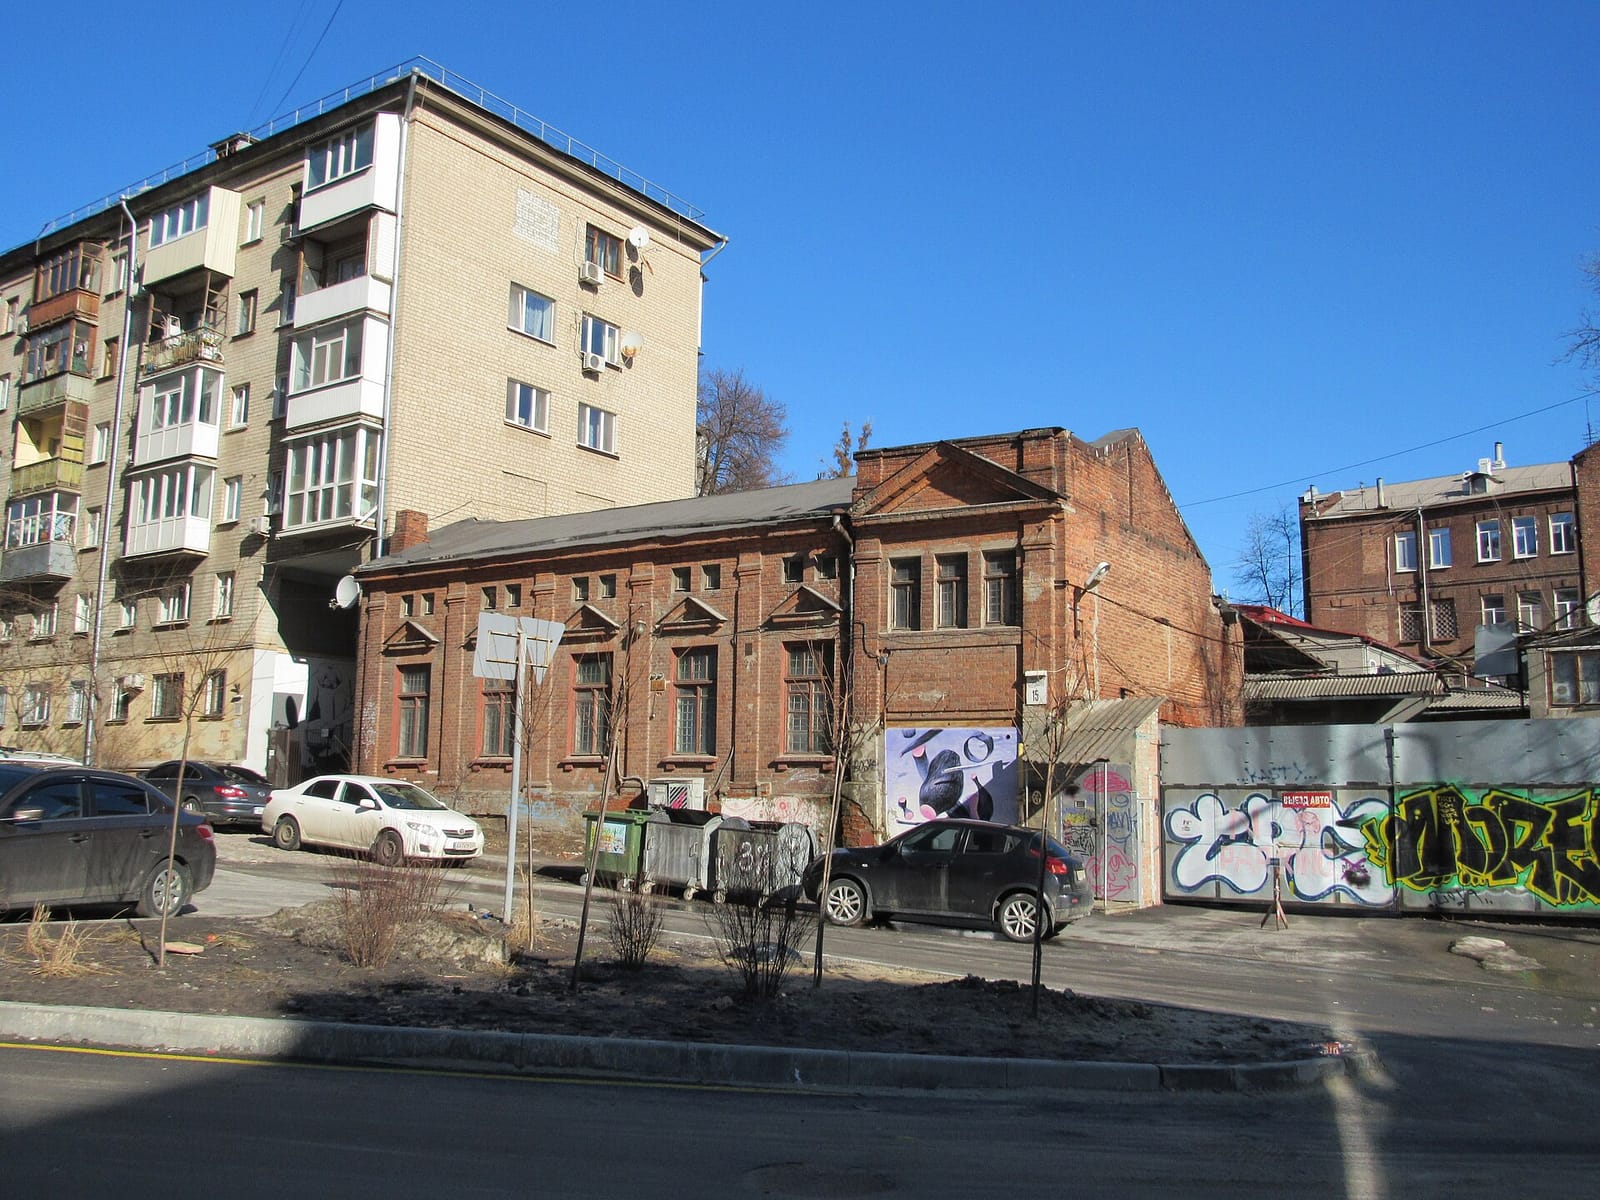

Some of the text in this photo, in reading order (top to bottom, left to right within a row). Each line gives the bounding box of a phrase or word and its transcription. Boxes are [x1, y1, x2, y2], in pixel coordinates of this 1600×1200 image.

[1032, 689, 1039, 702] 15
[1283, 795, 1330, 806] ВЫЕЗД АВТО
